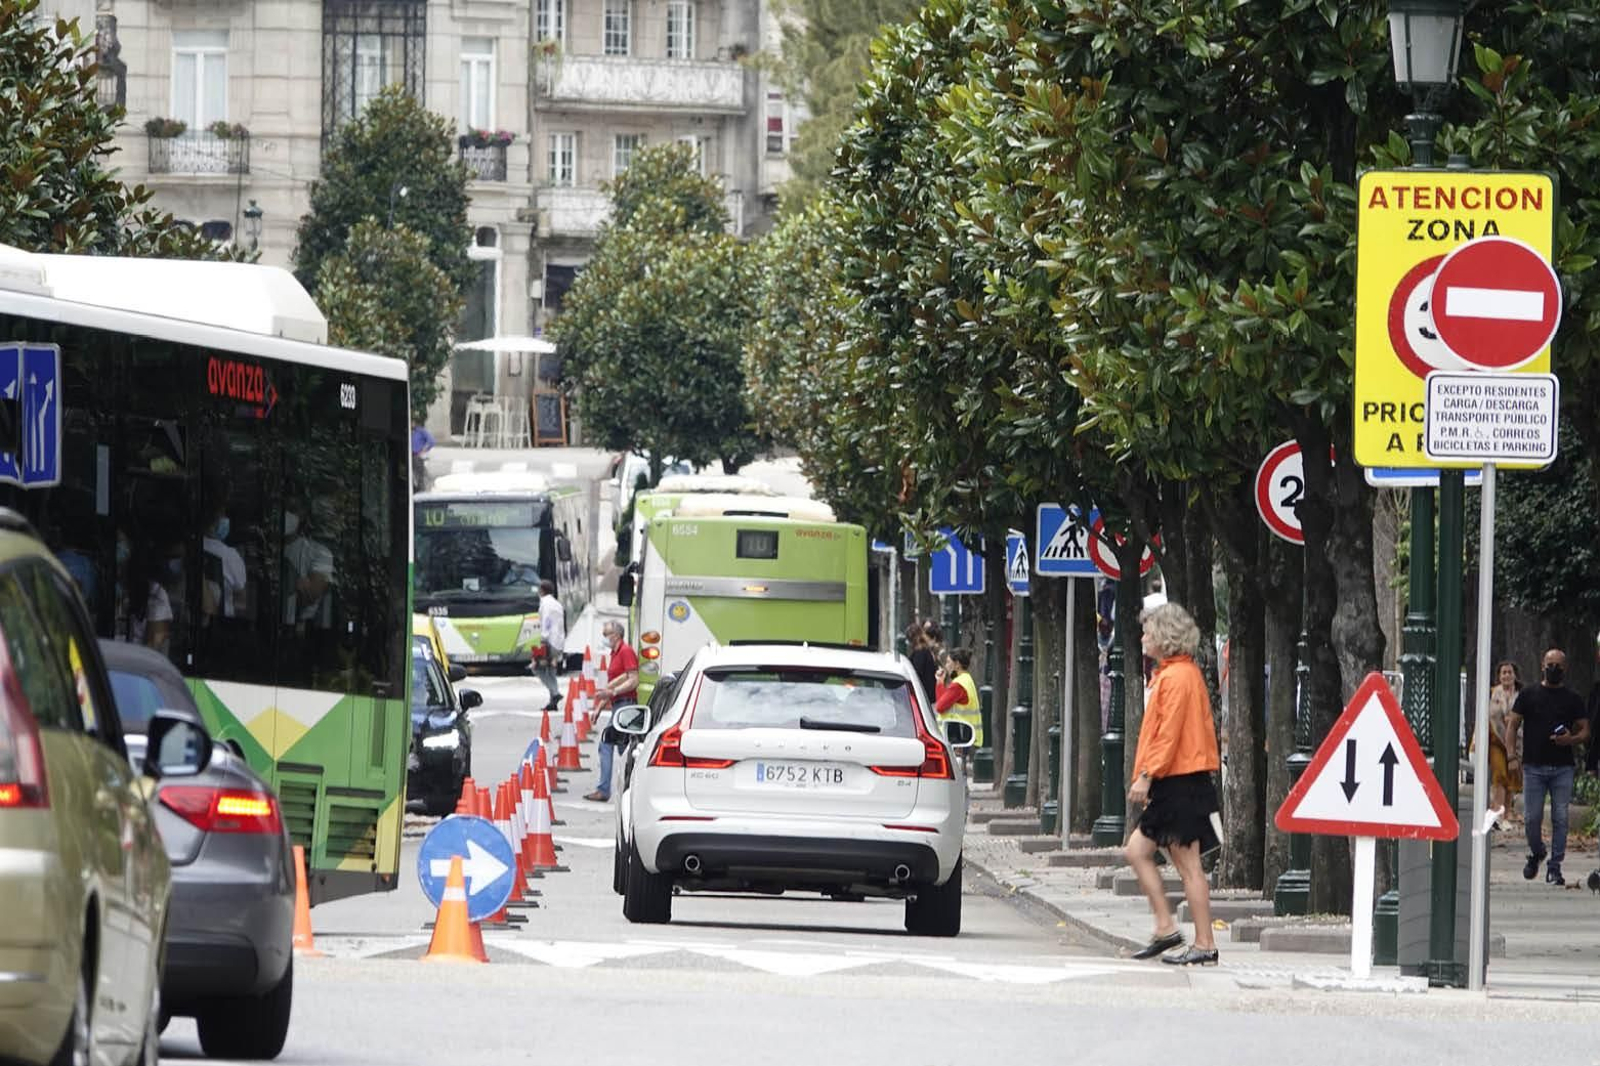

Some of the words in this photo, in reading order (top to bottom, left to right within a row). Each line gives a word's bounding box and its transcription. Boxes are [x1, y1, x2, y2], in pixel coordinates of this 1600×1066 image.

[1368, 185, 1543, 211] ATENCION
[1406, 219, 1500, 242] ZONA
[207, 355, 263, 403] avanza
[1437, 384, 1482, 396] EXCEPTO
[1484, 386, 1547, 398] RESIDENTES
[1435, 411, 1501, 424] TRANSPORTE
[1386, 432, 1405, 452] A
[1492, 429, 1540, 440] CORREOS
[1433, 440, 1491, 452] BICICLETAS
[1493, 442, 1499, 452] E
[1502, 443, 1547, 453] PARKING
[766, 765, 807, 783] 6752
[812, 769, 844, 784] KTB
